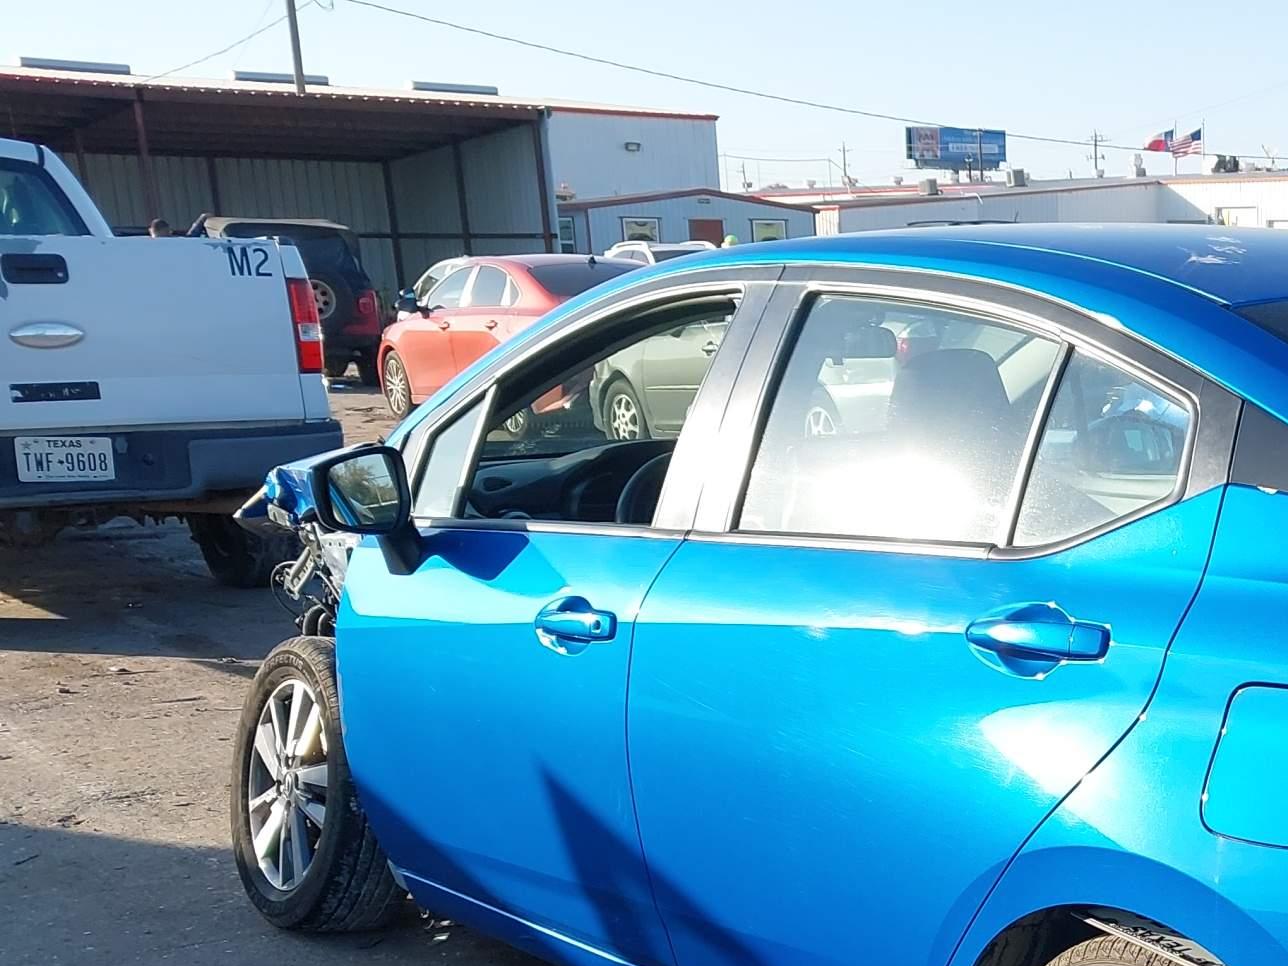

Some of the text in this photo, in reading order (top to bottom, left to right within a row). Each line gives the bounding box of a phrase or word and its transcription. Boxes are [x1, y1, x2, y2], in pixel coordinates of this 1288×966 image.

[227, 247, 272, 277] M2
[46, 439, 82, 448] TEXAS
[1130, 925, 1192, 956] TEXAS
